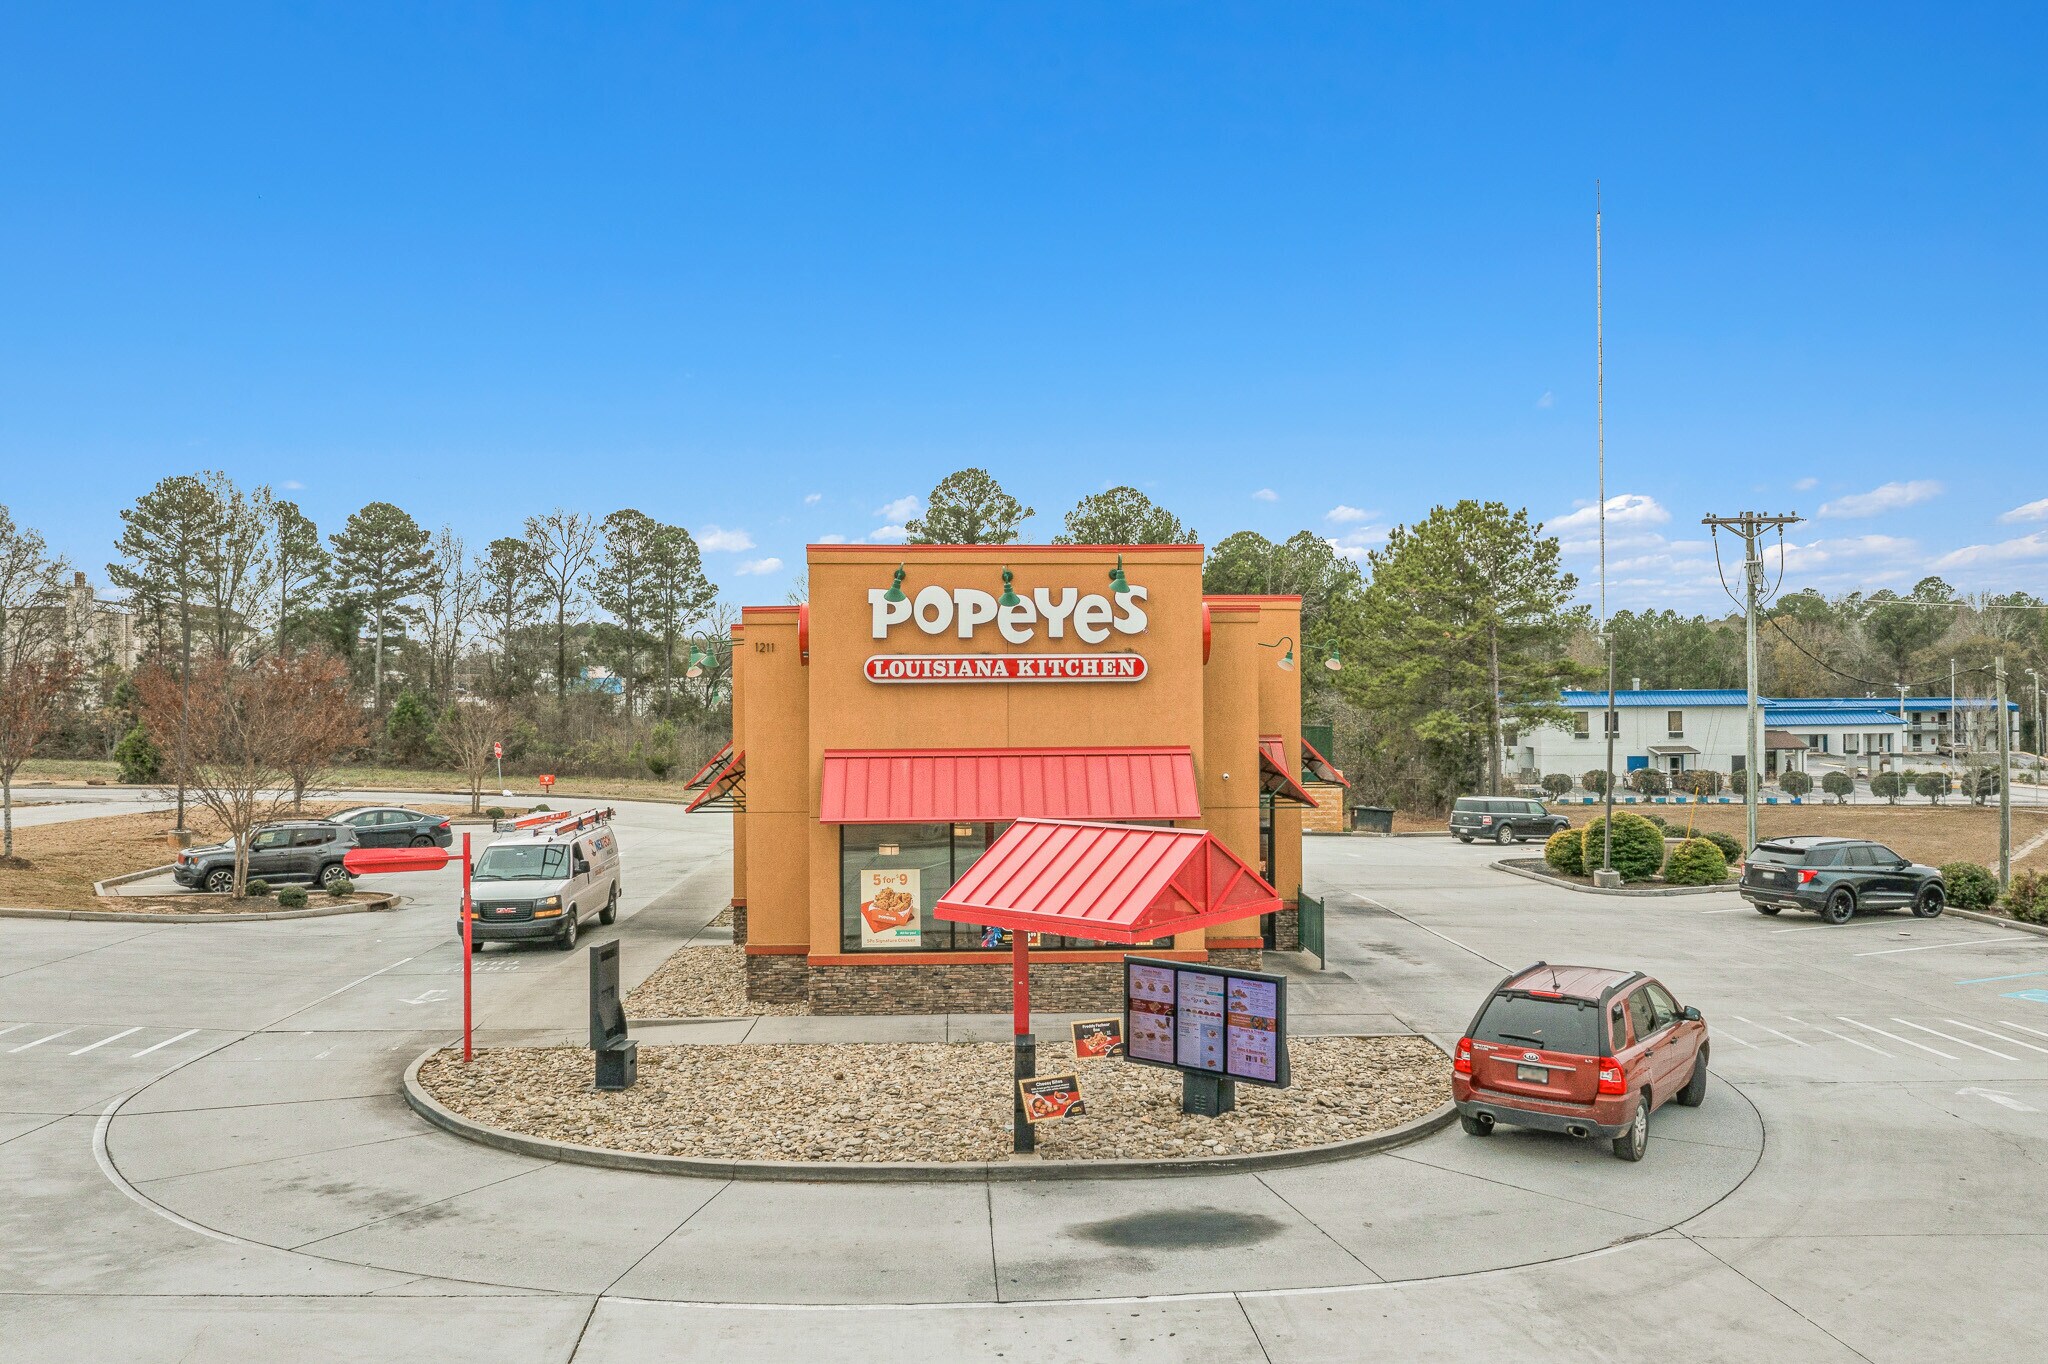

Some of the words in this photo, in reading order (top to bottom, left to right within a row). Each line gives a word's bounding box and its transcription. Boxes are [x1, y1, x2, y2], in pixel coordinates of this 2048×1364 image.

[754, 642, 775, 653] 1211
[873, 659, 1010, 678] LOUISIANA
[1016, 658, 1136, 677] KITCHEN
[873, 873, 881, 886] 5
[882, 876, 895, 884] for
